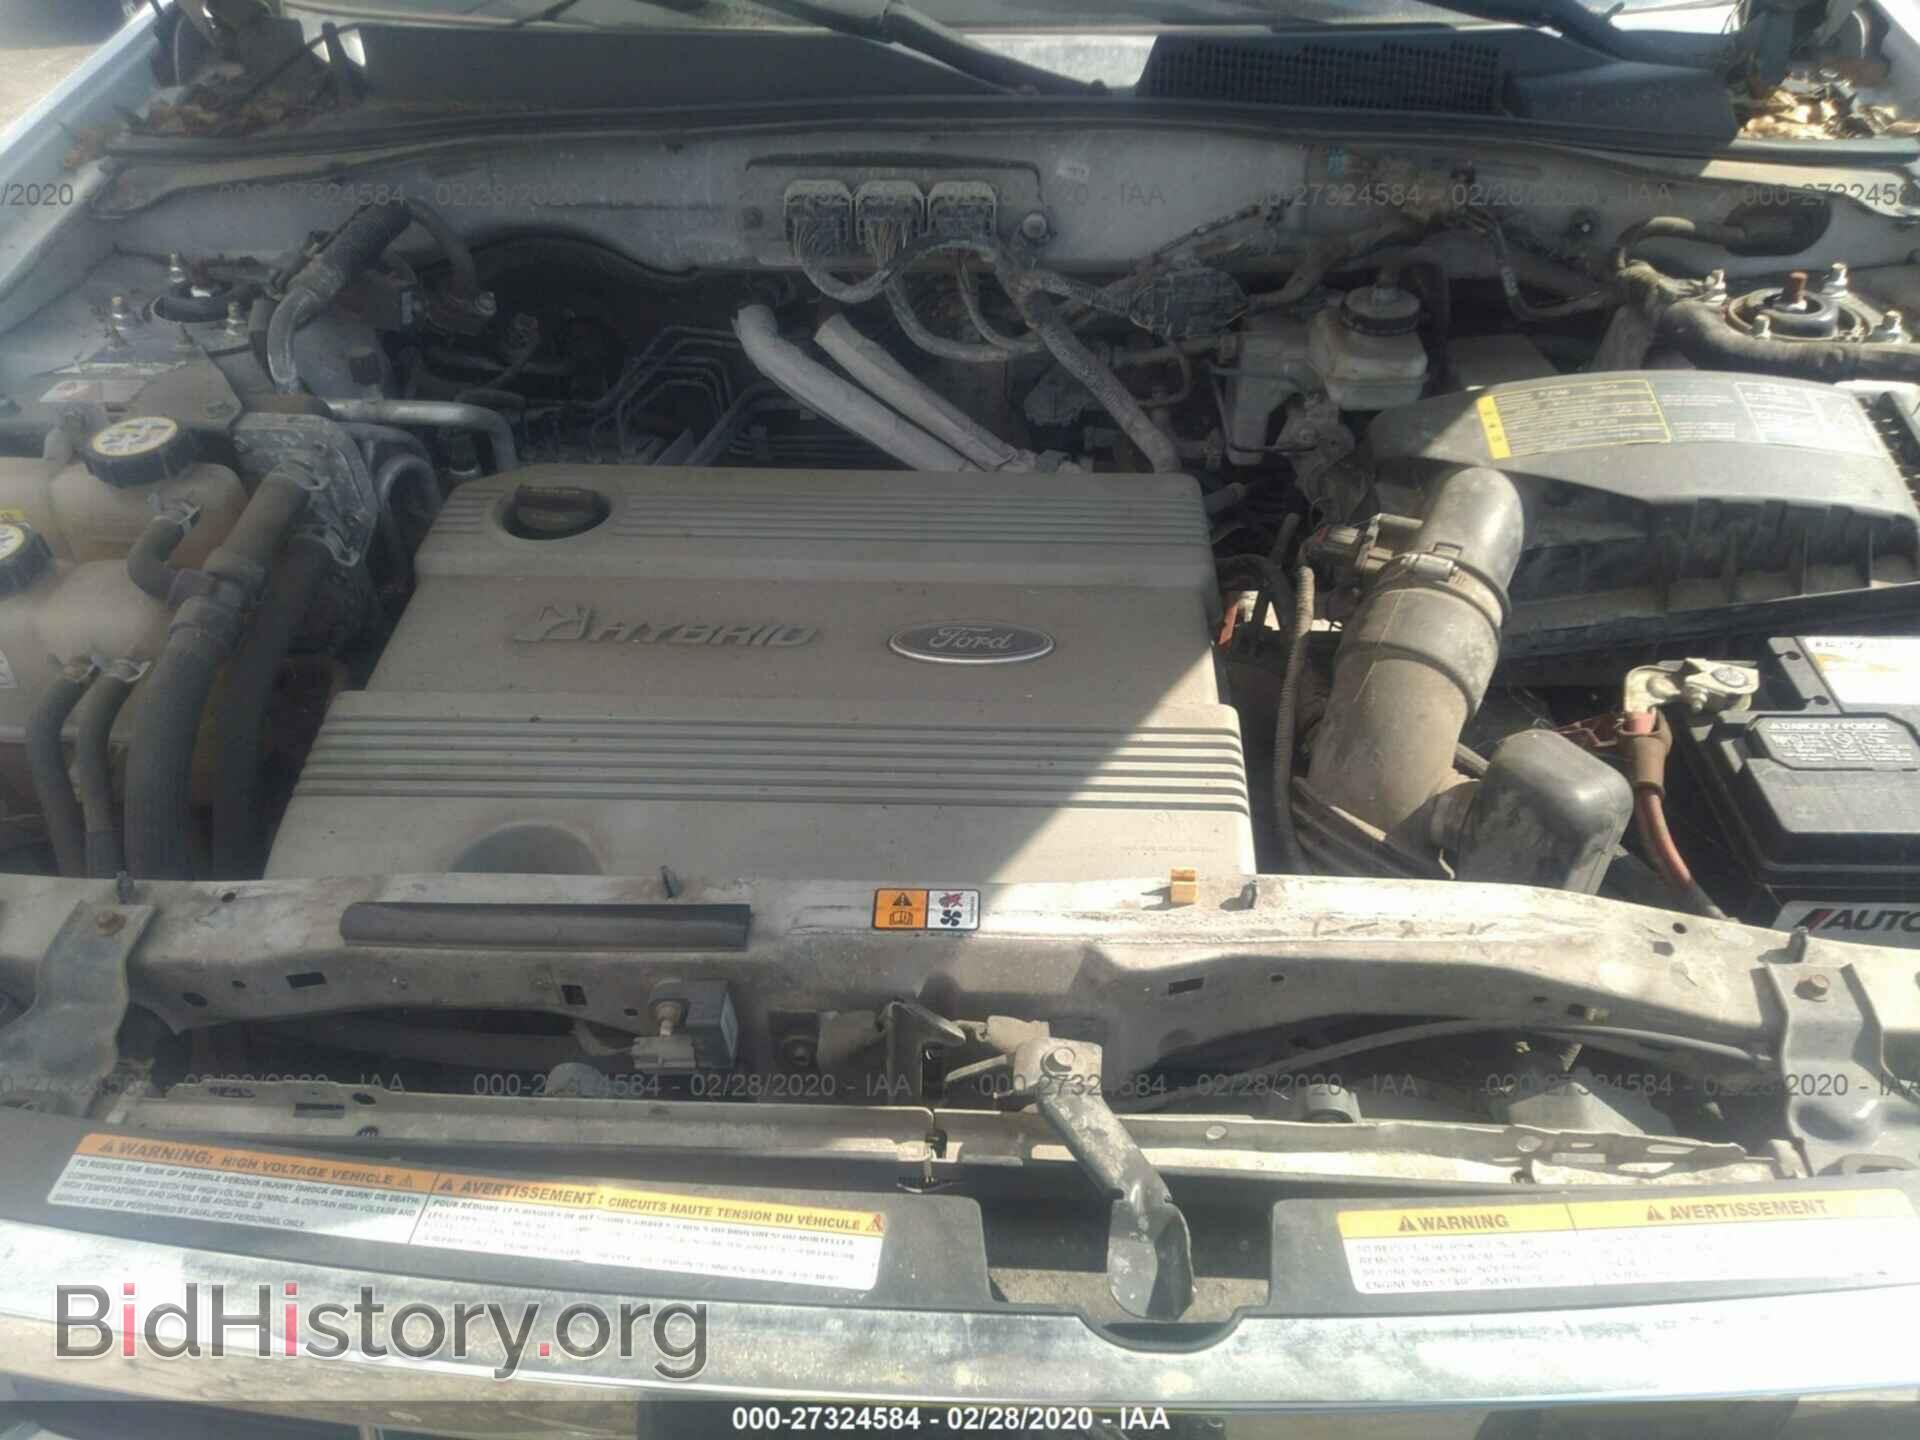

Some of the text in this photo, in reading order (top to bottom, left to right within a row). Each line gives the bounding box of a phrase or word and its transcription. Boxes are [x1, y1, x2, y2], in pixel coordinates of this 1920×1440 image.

[592, 622, 818, 648] HYBRID
[929, 626, 1015, 650] Ford
[118, 1141, 394, 1185] WARNING: HIGH VOLTAGE VEHICLE
[460, 1180, 597, 1206] AVERTISSEMENT
[608, 1196, 667, 1212] CIRCUITS
[671, 1203, 712, 1217] HAUTE
[717, 1207, 773, 1223] TENSION
[775, 1213, 794, 1224] DU
[1669, 1199, 1828, 1221] AVERTISSEMENT
[1416, 1214, 1509, 1231] WARNING
